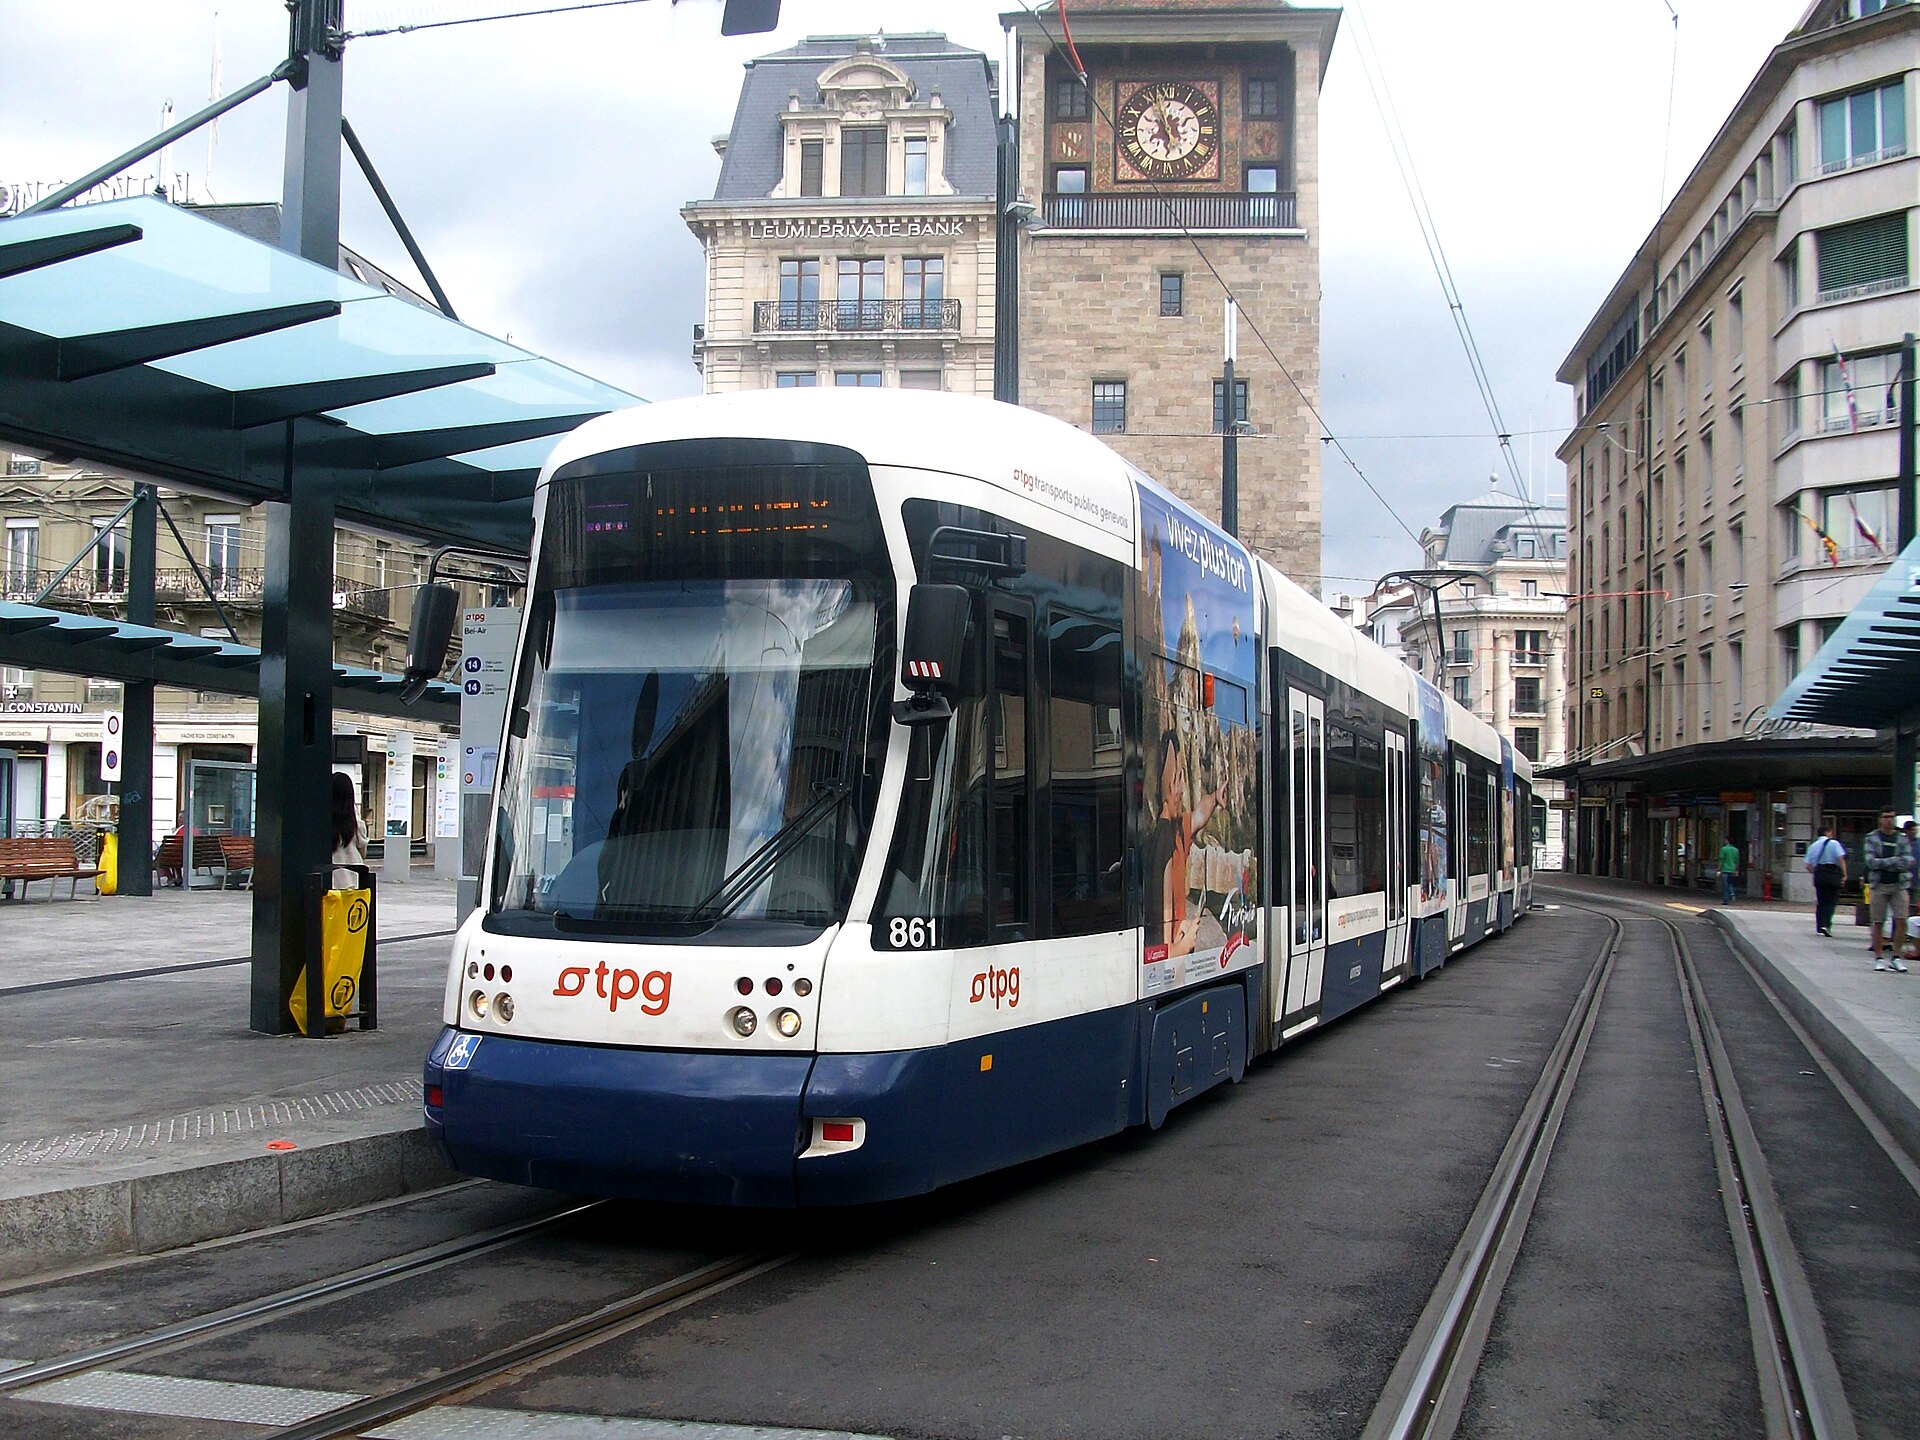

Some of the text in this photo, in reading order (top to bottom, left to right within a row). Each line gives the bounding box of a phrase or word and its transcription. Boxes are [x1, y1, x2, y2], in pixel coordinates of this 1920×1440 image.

[750, 222, 965, 239] LEUMI PRIVATE BANK
[1034, 475, 1073, 504] transports
[1073, 494, 1099, 515] publics
[1100, 507, 1128, 529] genevois
[467, 660, 478, 670] 14
[467, 683, 477, 692] 14
[1591, 689, 1604, 698] 25
[9, 702, 82, 713] CONSTANTIN
[889, 917, 936, 948] 861
